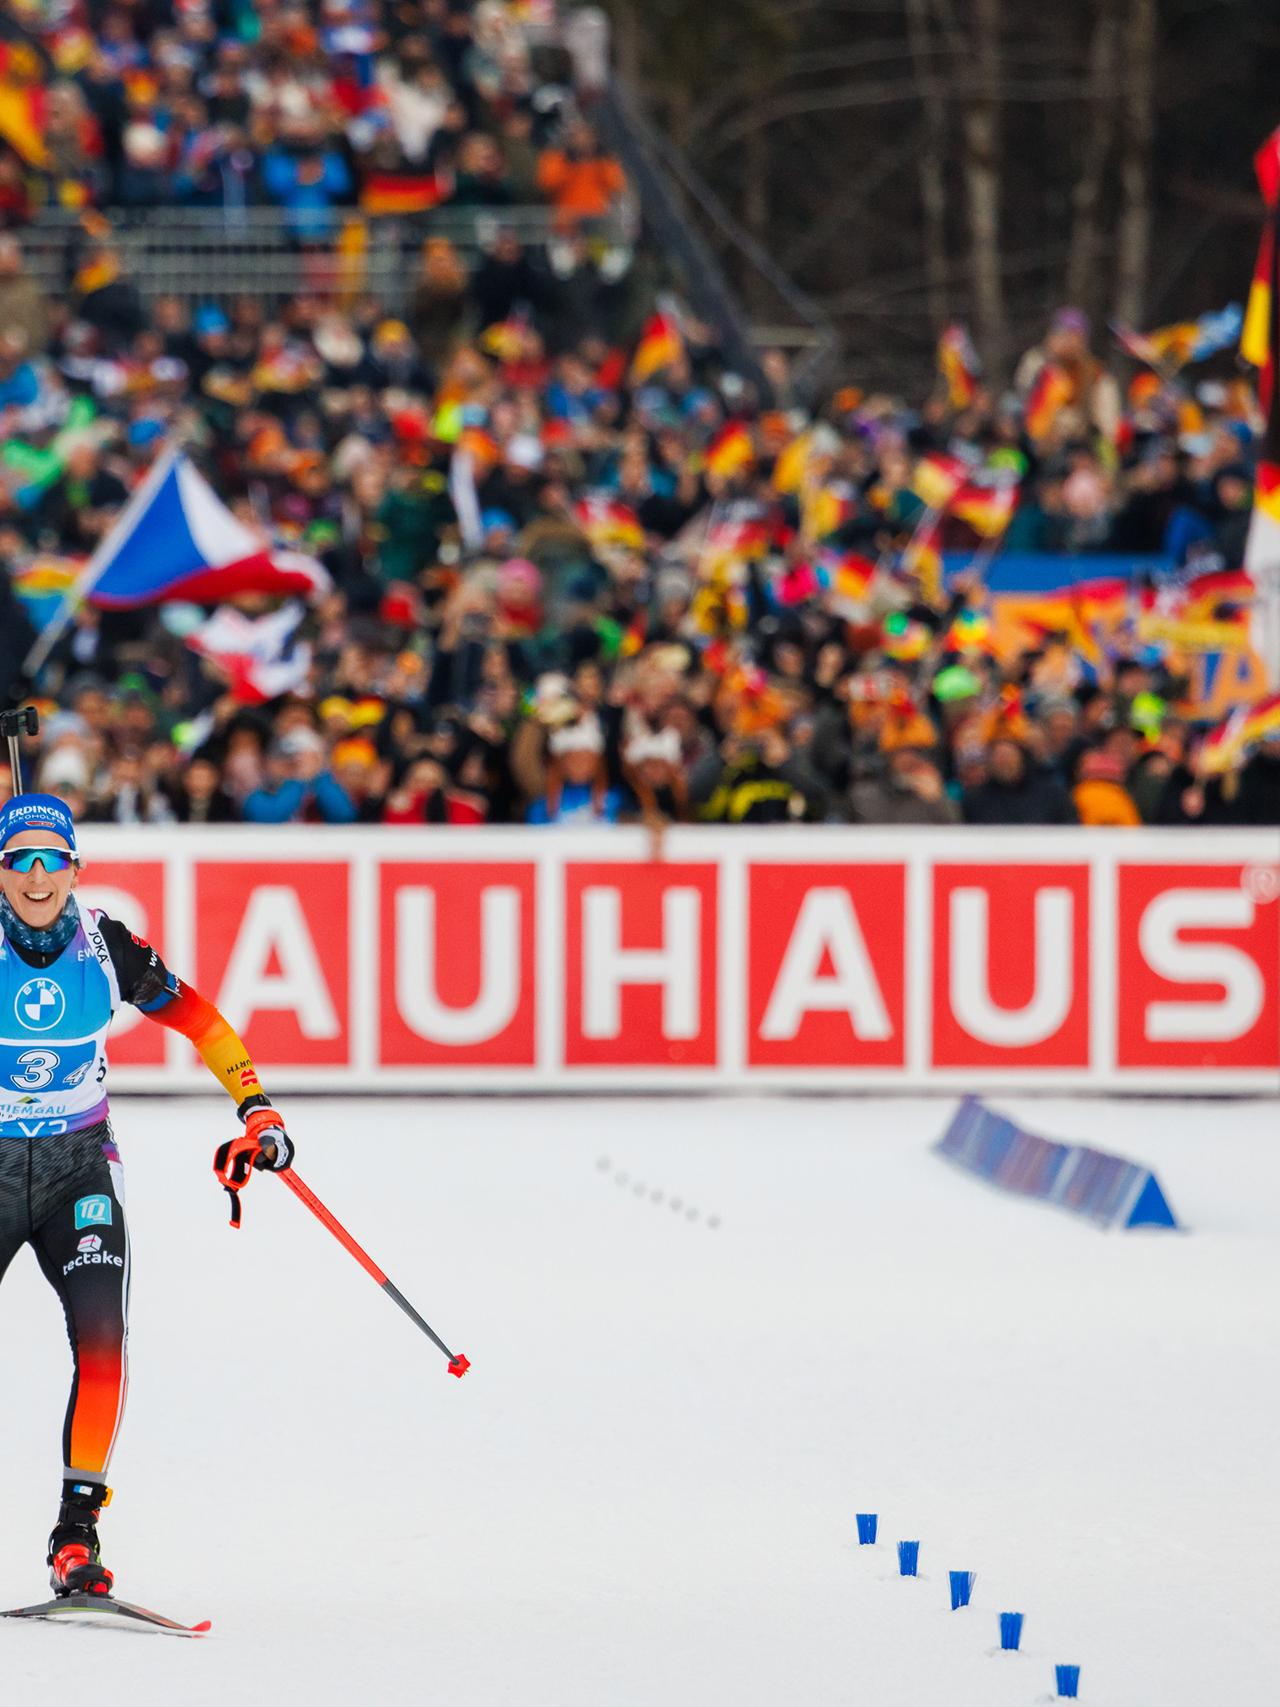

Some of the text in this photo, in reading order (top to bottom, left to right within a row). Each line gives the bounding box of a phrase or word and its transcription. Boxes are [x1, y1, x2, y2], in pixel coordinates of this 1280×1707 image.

[9, 805, 67, 824] ERDINGER
[77, 948, 96, 962] EW
[89, 931, 109, 964] JOKA
[23, 980, 58, 995] BMW
[10, 1048, 61, 1091] 3
[62, 1060, 93, 1086] 4
[79, 1198, 106, 1221] TQ
[62, 1250, 124, 1276] tectake
